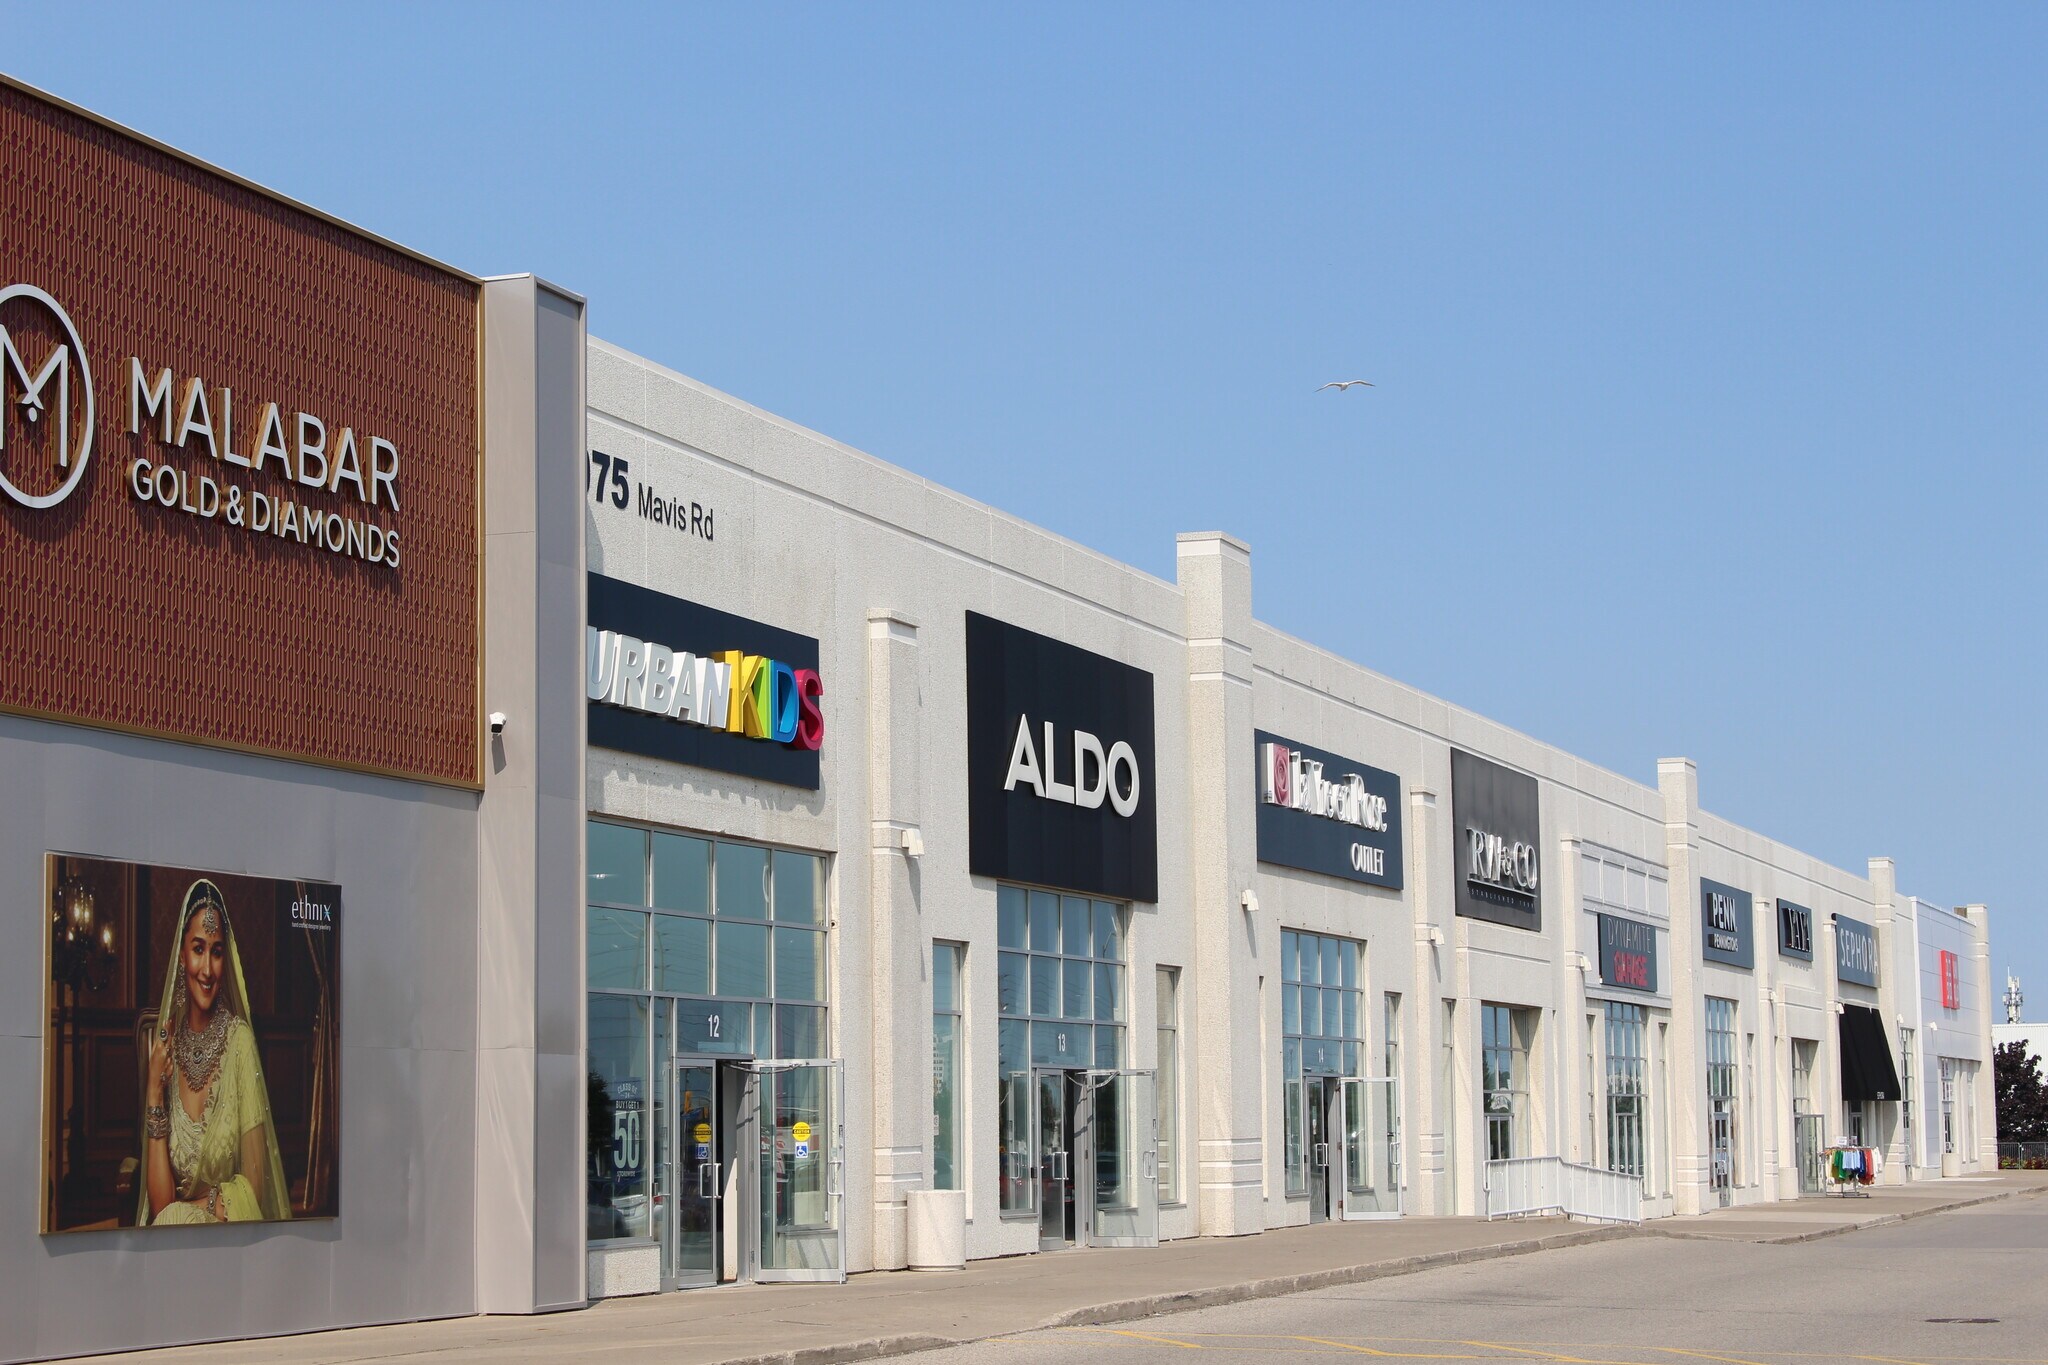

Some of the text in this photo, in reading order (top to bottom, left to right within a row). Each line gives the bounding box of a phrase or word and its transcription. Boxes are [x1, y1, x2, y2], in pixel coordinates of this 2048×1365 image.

[128, 356, 400, 511] MALABAR
[130, 457, 400, 568] GOLD & DIAMONDS
[586, 449, 714, 541] 75 Mavis Rd
[1004, 713, 1141, 819] ALDO
[1351, 842, 1385, 877] OUTLET
[291, 894, 332, 922] ethnix
[1607, 917, 1651, 954] DYNAMITE
[1839, 927, 1880, 976] SEPHORA
[1614, 949, 1648, 988] GARAGE
[707, 1014, 720, 1038] 12
[1057, 1032, 1067, 1053] 13
[616, 1101, 625, 1109] BUY
[628, 1101, 637, 1110] GET
[613, 1110, 640, 1170] 50
